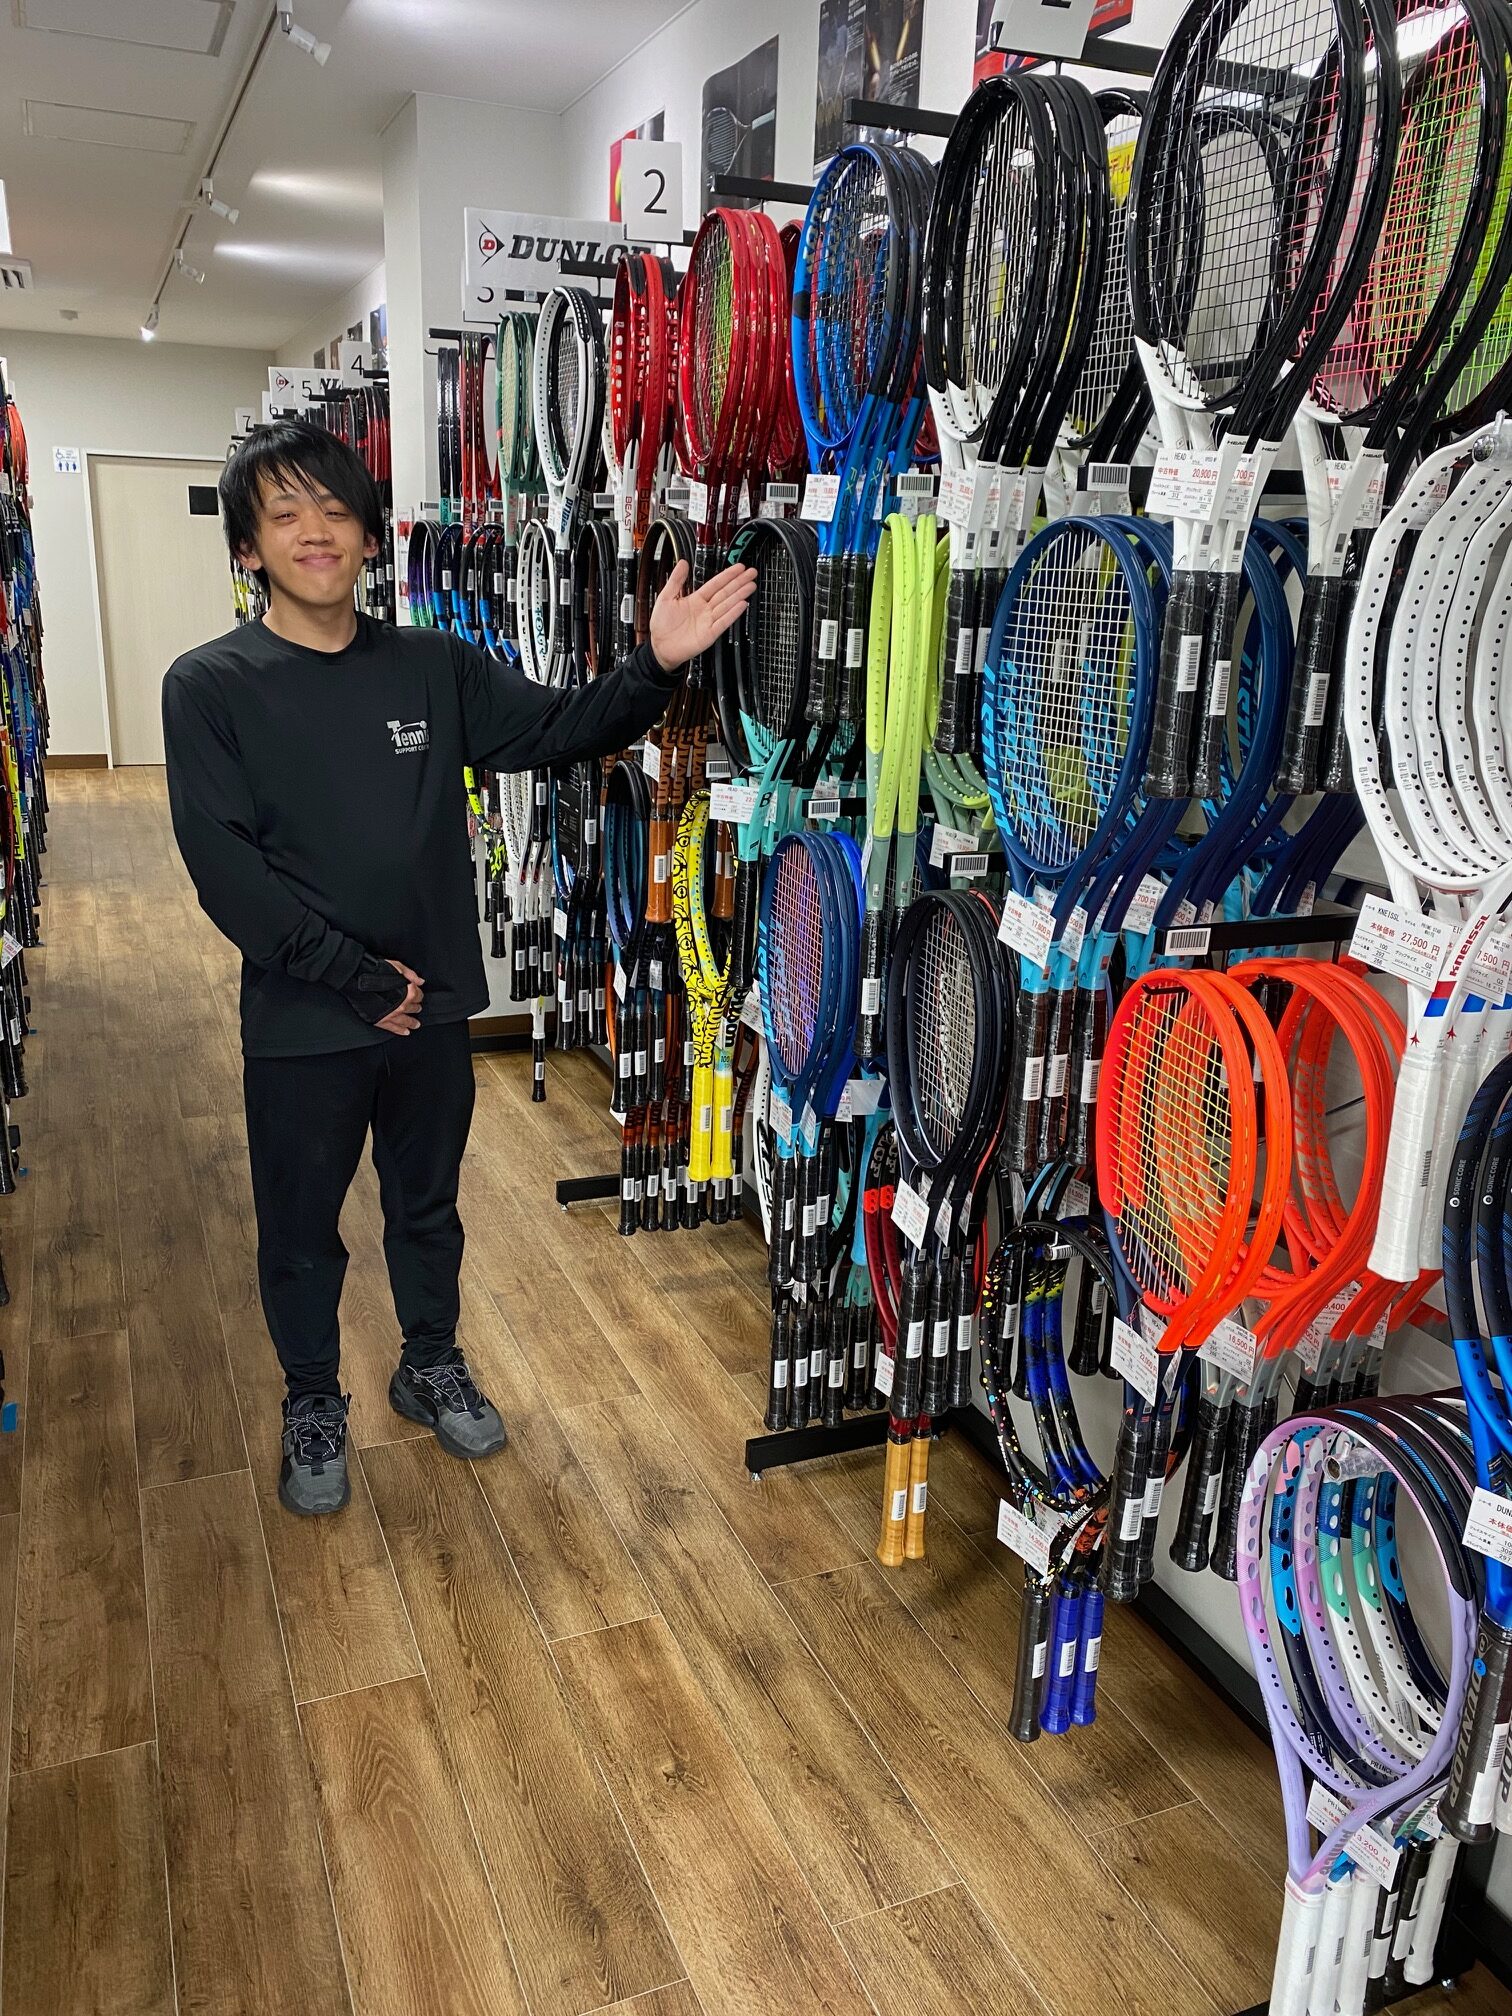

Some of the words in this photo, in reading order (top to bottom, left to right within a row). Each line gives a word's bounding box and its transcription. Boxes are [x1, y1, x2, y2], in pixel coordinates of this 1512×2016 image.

[643, 169, 667, 214] 2
[351, 355, 364, 376] 4
[302, 380, 312, 398] 5
[243, 415, 251, 431] 7
[1211, 470, 1218, 480] 円
[1233, 469, 1248, 480] ,700
[1248, 471, 1256, 481] 円
[560, 497, 574, 534] prince
[624, 495, 633, 533] BEAST
[690, 724, 709, 790] Wilso
[1134, 894, 1149, 904] ,700
[1377, 907, 1400, 922] KNEISSL
[1370, 922, 1396, 937] 本体価格
[1400, 931, 1428, 950] 27,500
[1430, 944, 1441, 956] 円
[1501, 959, 1511, 971] 円
[1456, 1159, 1467, 1177] CORE
[1490, 1156, 1500, 1174] CORE
[1453, 1176, 1463, 1196] SONIC
[1486, 1174, 1496, 1193] SONIC
[1228, 1334, 1248, 1351] 16,500
[1248, 1345, 1255, 1355] 円
[1496, 1504, 1512, 1518] DUN
[1488, 1517, 1512, 1534] 本体価
[1450, 1672, 1482, 1808] DUNLOP
[1382, 1855, 1391, 1868] 円
